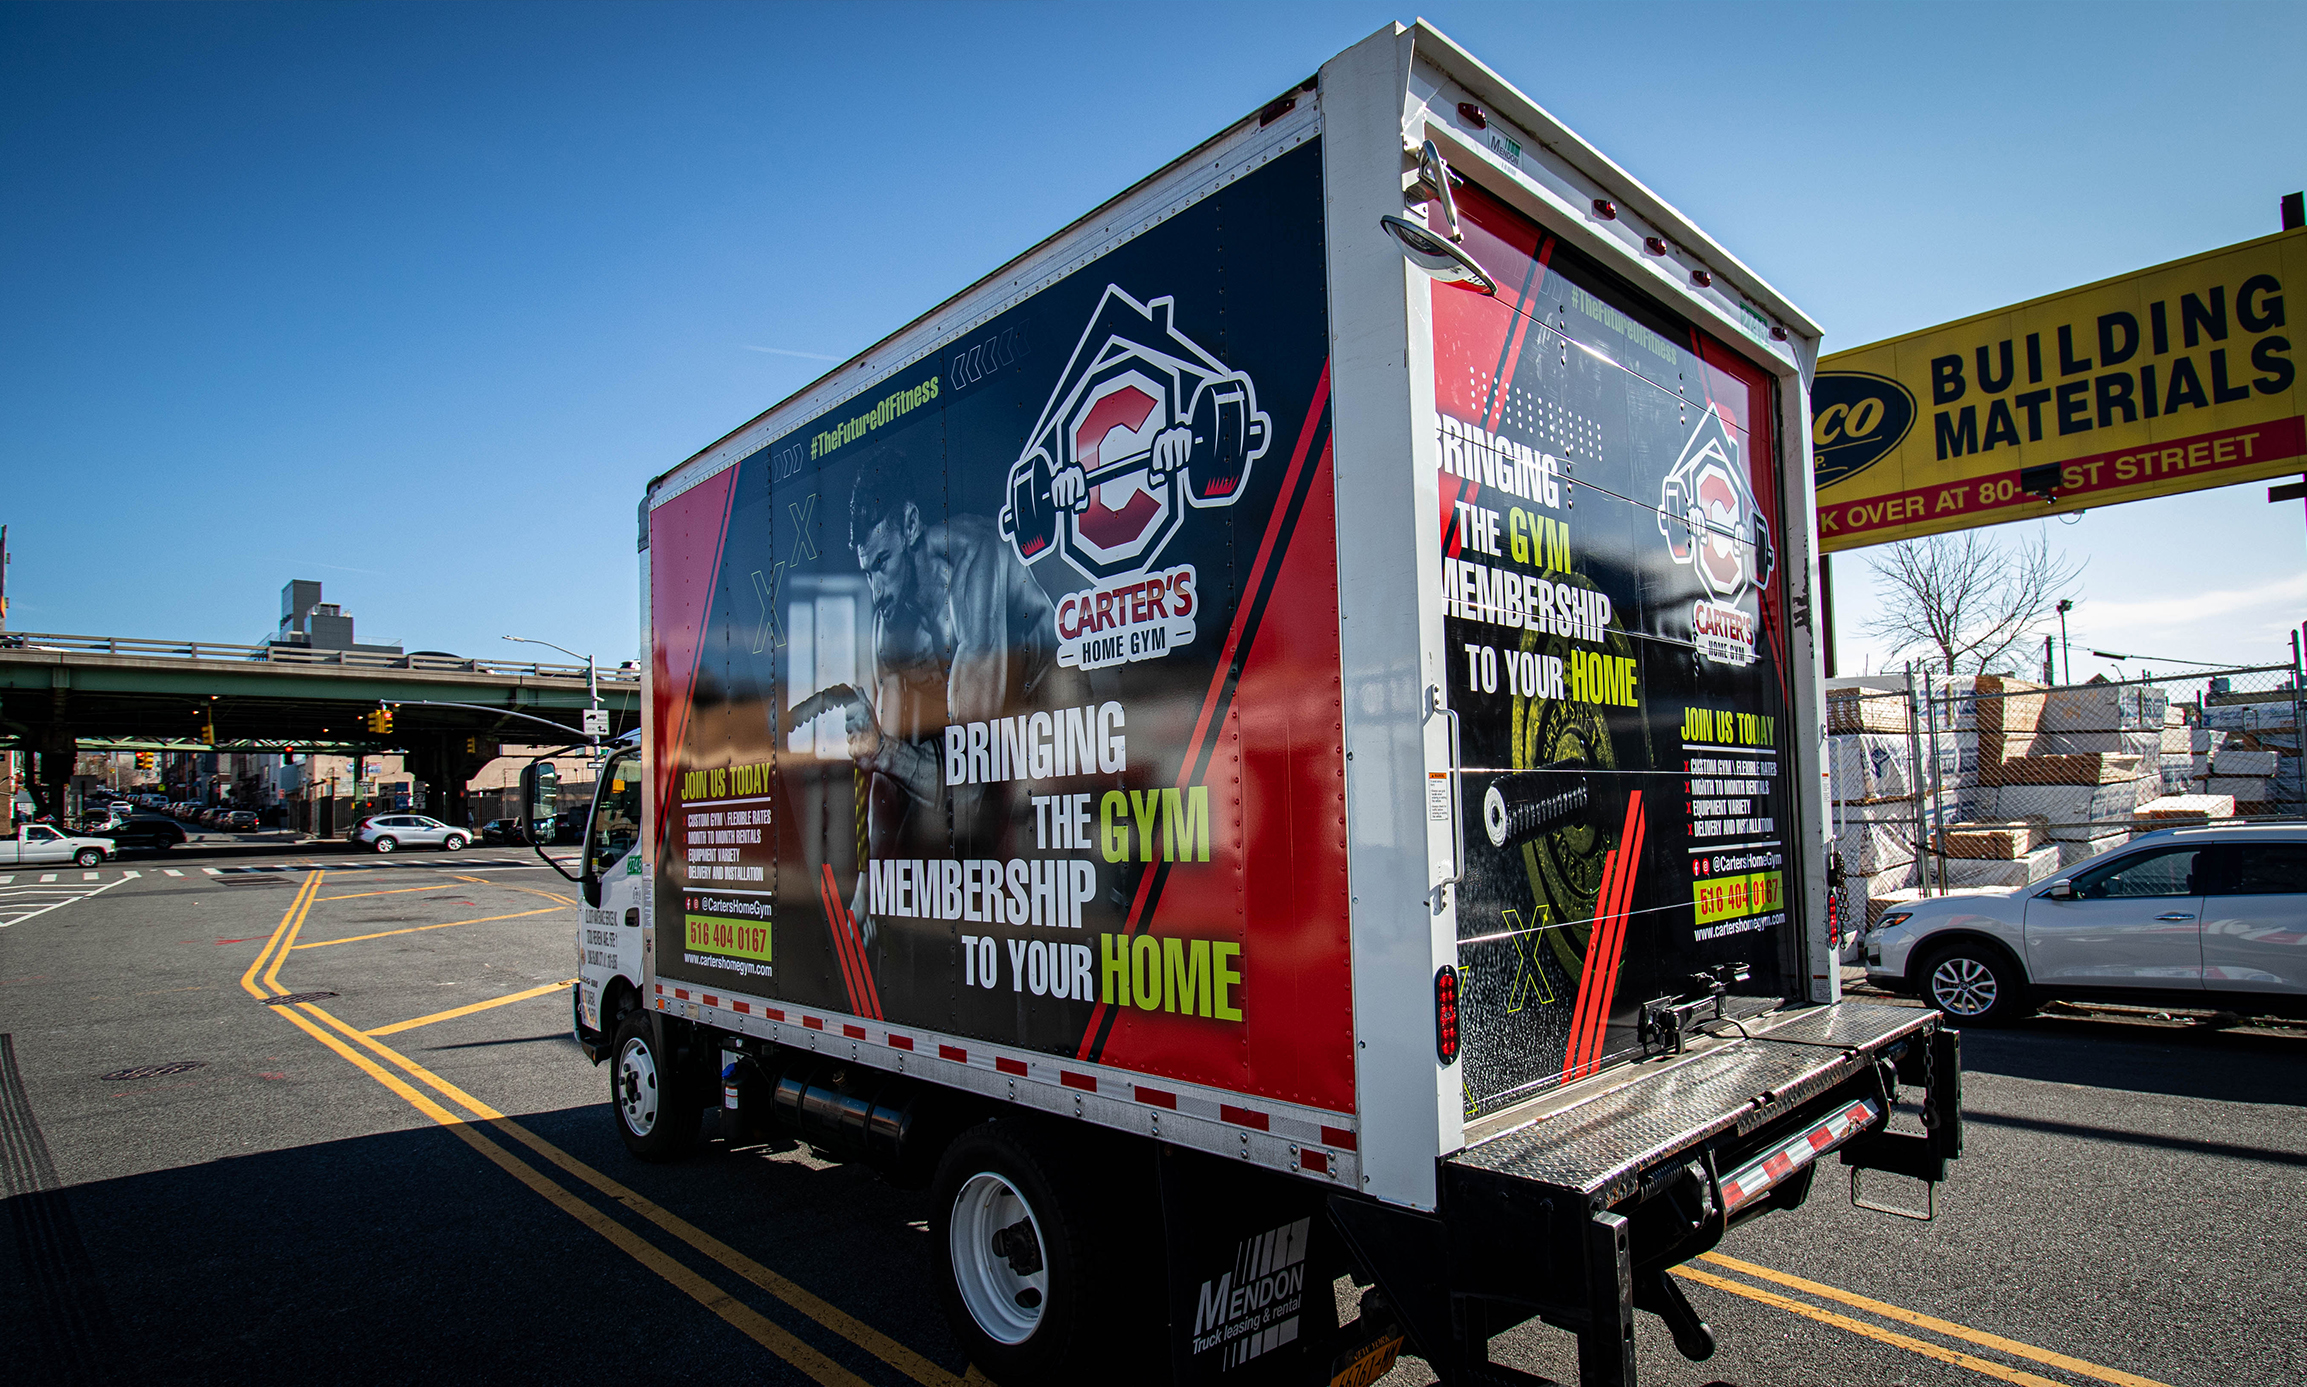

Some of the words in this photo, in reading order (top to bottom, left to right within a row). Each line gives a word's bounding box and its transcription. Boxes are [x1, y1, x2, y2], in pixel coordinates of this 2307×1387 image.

[1490, 135, 1519, 165] MENDON
[1571, 284, 1677, 366] #TheFutureOfFitness
[1930, 273, 2286, 406] BUILDING
[1934, 335, 2295, 461] MATERIALS
[810, 375, 939, 460] #TheFutureOfFitness
[1847, 495, 1925, 528] OVER
[1933, 486, 1970, 514] AT
[2115, 432, 2260, 480] STREET
[1454, 499, 1501, 558] THE
[1509, 506, 1572, 575] GYM
[1059, 572, 1193, 640] CARTER'S
[1696, 604, 1753, 646] CARTER'S
[1082, 635, 1124, 664] HOME
[1130, 626, 1166, 655] GYM
[1708, 640, 1727, 658] HOME
[1730, 644, 1745, 662] GYM
[1464, 643, 1497, 694] TO
[1504, 650, 1564, 700] YOUR
[1571, 649, 1638, 708] HOME
[945, 701, 1127, 786] BRINGING
[1681, 706, 1713, 742] JOIN
[1716, 710, 1734, 744] US
[1736, 712, 1774, 746] TODAY
[681, 770, 707, 800] JOIN
[710, 767, 726, 798] US
[729, 762, 770, 796] TODAY
[1690, 758, 1717, 775] CUSTOM
[1717, 759, 1731, 775] GYM
[1736, 760, 1760, 776] FLEXIBLE
[1760, 761, 1777, 776] RATES
[1691, 779, 1714, 795] MONTH
[1715, 779, 1723, 795] TO
[1724, 779, 1745, 795] MONTH
[1745, 780, 1769, 795] RENTALS
[688, 813, 709, 827] CUSTOM
[710, 812, 722, 826] GYM
[727, 810, 751, 826] FLEXIBLE
[752, 809, 771, 824] RATES
[1031, 793, 1092, 849] THE
[1100, 785, 1210, 863] GYM
[1692, 799, 1727, 818] EQUIPMENT
[1727, 799, 1751, 815] VARIETY
[1694, 819, 1722, 837] DELIVERY
[1723, 819, 1735, 835] AND
[1736, 818, 1774, 834] INSTALLATION
[688, 831, 706, 845] MONTH
[707, 830, 714, 844] TO
[715, 830, 735, 844] MONTH
[736, 829, 761, 844] RENTALS
[688, 848, 716, 863] EQUIPMENT
[718, 848, 740, 862] VARIETY
[688, 866, 711, 879] DELIVERY
[712, 866, 724, 880] AND
[724, 866, 763, 881] INSTALLATION
[1712, 852, 1782, 872] @CartersHomeGym
[702, 897, 772, 919] @CartersHomeGym
[869, 858, 1097, 928] MEMBERSHIP
[1700, 886, 1723, 915] 516
[1728, 883, 1748, 909] 404
[1752, 878, 1778, 906] 0167
[690, 921, 709, 946] 516
[713, 924, 733, 949] 404
[737, 926, 767, 953] 0167
[1694, 913, 1785, 942] www.cartershomegym.com
[684, 953, 772, 977] www.cartershomegym.com
[961, 935, 997, 989] TO
[1007, 938, 1094, 1003] YOUR
[1100, 932, 1243, 1022] HOME
[1194, 1263, 1304, 1337] MENDON
[1193, 1329, 1222, 1355] Truck
[1224, 1313, 1261, 1341] leasing
[1262, 1307, 1270, 1323] &
[1272, 1293, 1301, 1319] rental
